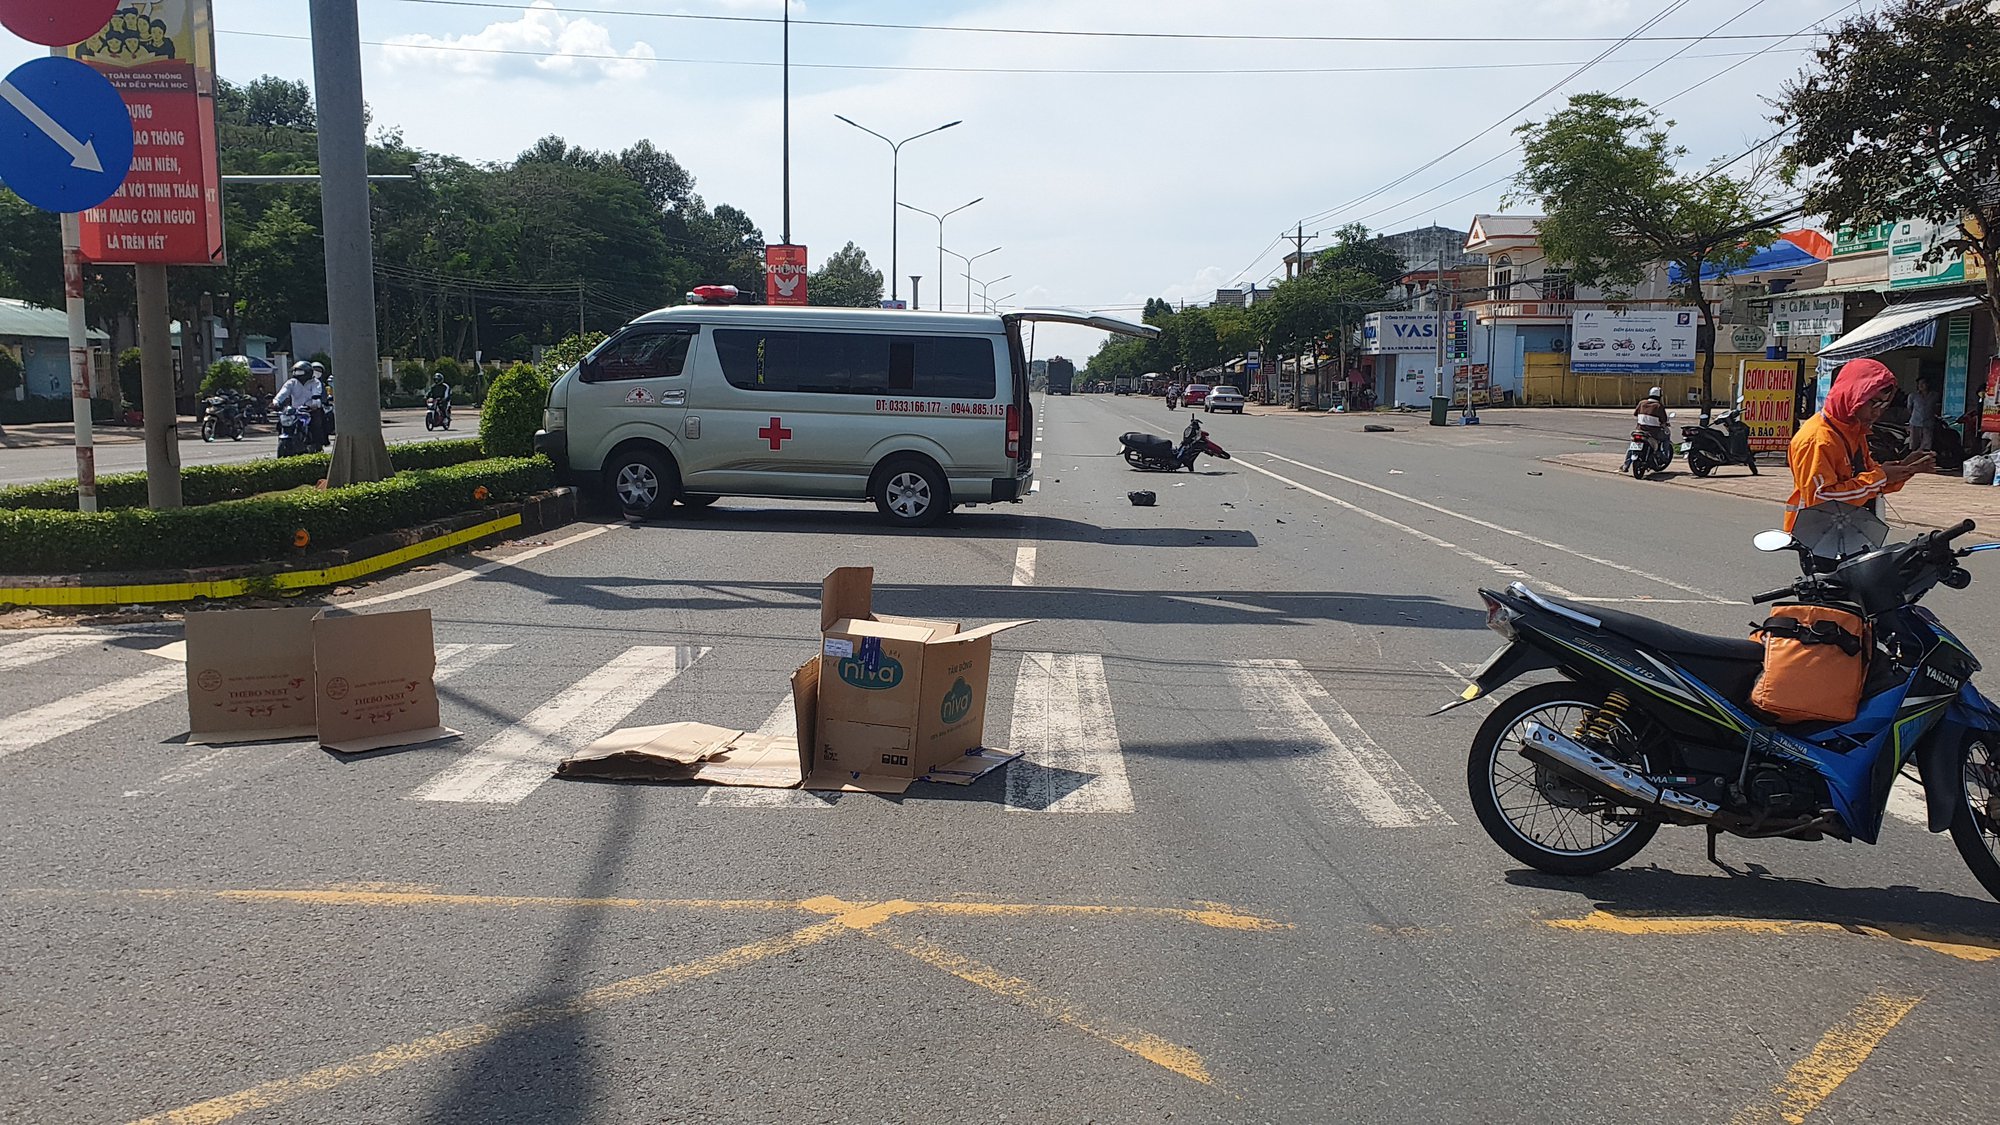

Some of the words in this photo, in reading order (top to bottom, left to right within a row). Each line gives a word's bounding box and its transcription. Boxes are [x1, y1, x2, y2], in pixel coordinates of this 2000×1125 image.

[147, 183, 171, 198] TINH
[141, 209, 161, 224] CON
[889, 400, 941, 413] 0333.166.177
[950, 402, 1004, 416] 0944.885.115
[1926, 665, 1959, 690] YAMAHA
[1780, 736, 1808, 755] YAMAHA
